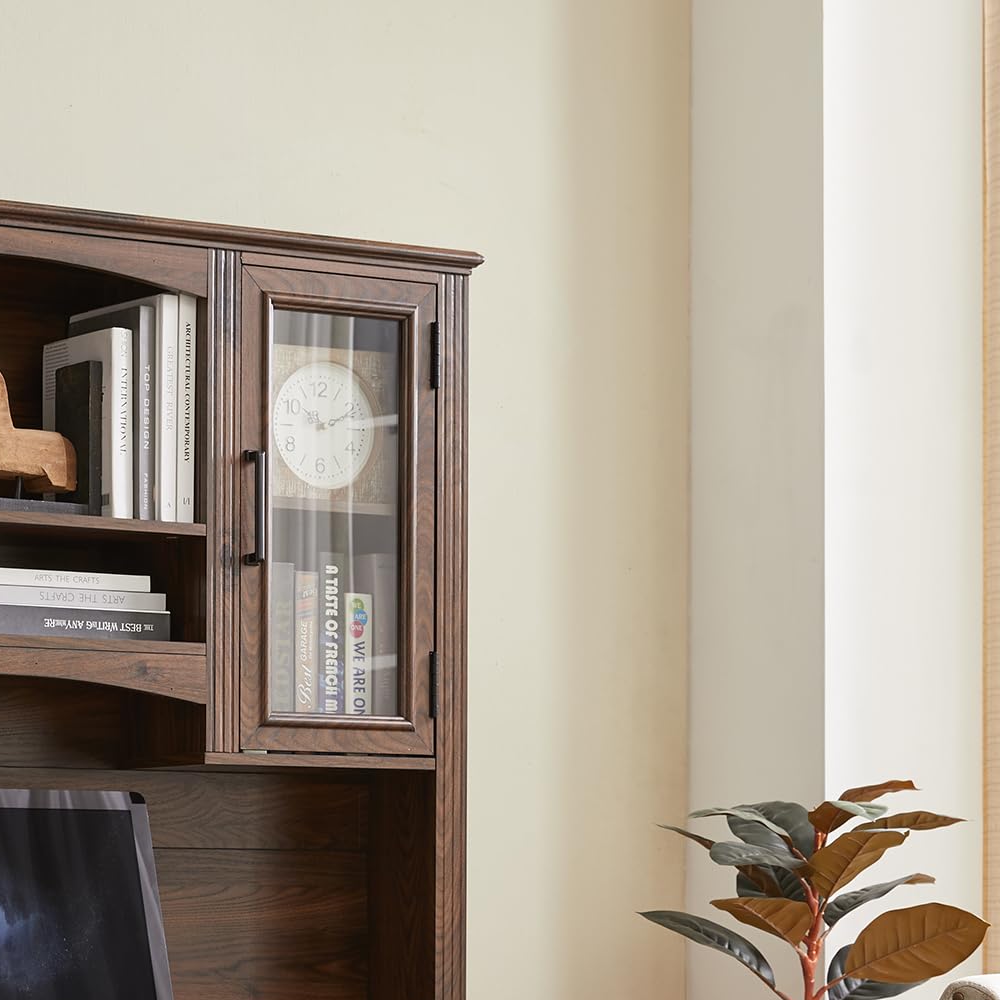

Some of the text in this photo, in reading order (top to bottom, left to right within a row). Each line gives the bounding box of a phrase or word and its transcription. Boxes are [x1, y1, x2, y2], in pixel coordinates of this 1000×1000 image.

[183, 321, 192, 463] ARCHITECTURAL CONTEMPORARY
[311, 382, 328, 398] 12
[120, 367, 128, 456] INTERNATIONAL
[143, 364, 151, 450] TOP DESIGN
[166, 401, 174, 431] RIVER
[284, 399, 300, 415] 10
[285, 436, 295, 452] 8
[345, 441, 355, 455] 4
[315, 458, 326, 473] 6
[34, 573, 101, 584] ARTS THE CRAFTS
[325, 565, 338, 574] A
[39, 592, 125, 604] ARTS THE CRAFTS
[325, 578, 338, 616] TASTE
[86, 620, 118, 631] WRITING
[119, 623, 142, 632] BEST
[325, 620, 338, 639] OF
[300, 620, 308, 661] GARAGE
[353, 641, 365, 662] WE
[325, 642, 338, 695] FRENCH
[296, 664, 313, 708] Best
[353, 667, 365, 693] ARE
